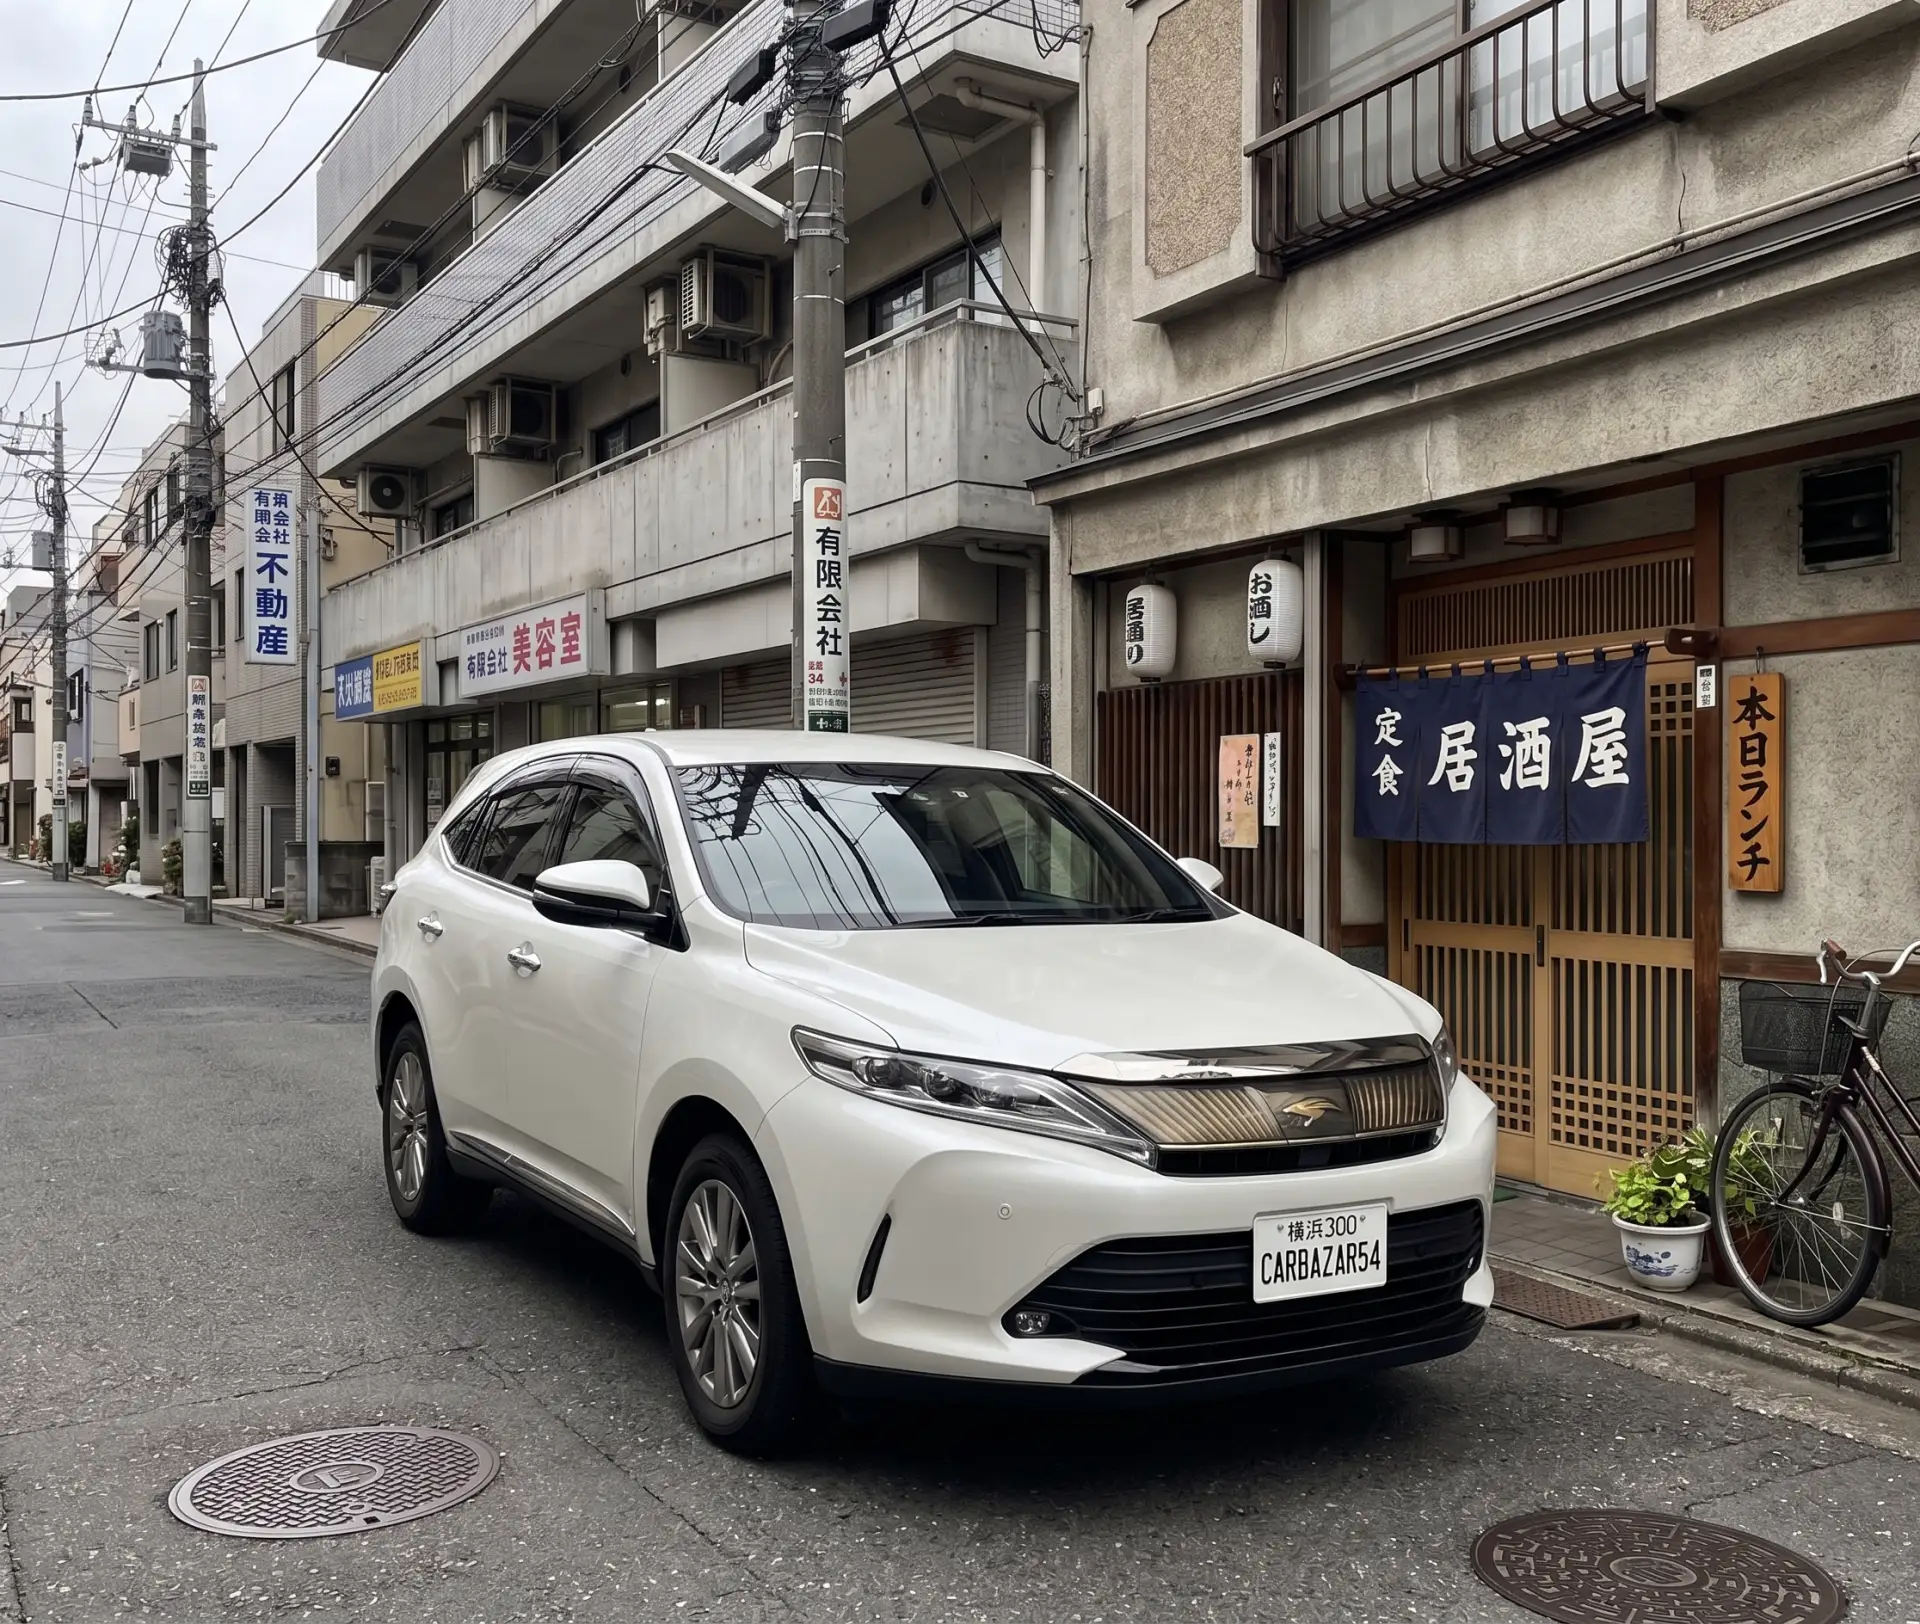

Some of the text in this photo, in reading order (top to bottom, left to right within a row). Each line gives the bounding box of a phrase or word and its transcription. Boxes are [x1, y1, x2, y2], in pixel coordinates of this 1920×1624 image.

[255, 552, 289, 655] 不動産
[815, 526, 842, 656] 有限会社
[467, 646, 508, 680] 有限会社
[513, 611, 581, 675] 美容室
[808, 673, 824, 684] 34
[1372, 707, 1404, 796] 定食
[1428, 706, 1631, 792] 居酒屋
[1732, 685, 1776, 882] 本日ランチ
[1261, 1239, 1381, 1285] CARBAZAR54
[1287, 1214, 1357, 1242] 横浜300
